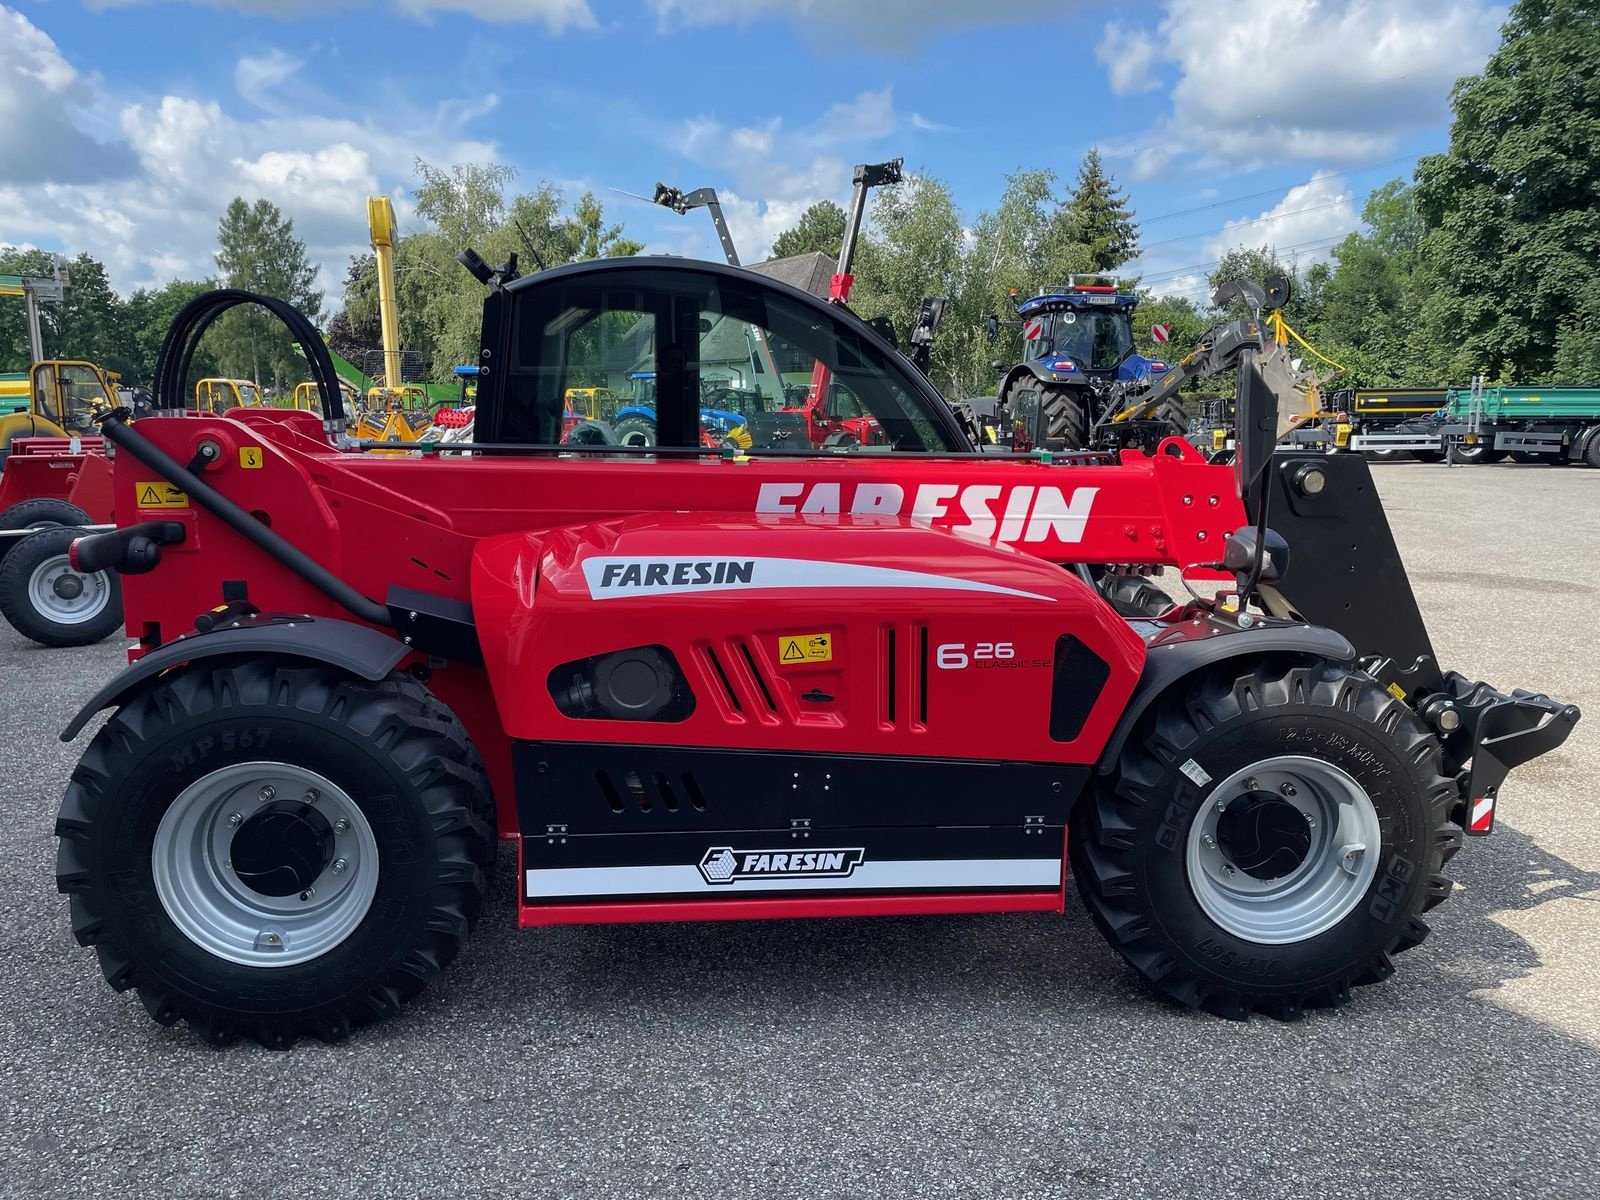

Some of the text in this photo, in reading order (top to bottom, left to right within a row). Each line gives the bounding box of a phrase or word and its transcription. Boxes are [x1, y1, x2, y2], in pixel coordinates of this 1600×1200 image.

[1065, 313, 1075, 322] 50
[600, 561, 755, 587] FARESIN
[937, 642, 1015, 669] 6 26
[975, 660, 1027, 669] CLASSIC
[222, 728, 273, 751] 567
[1156, 783, 1198, 850] BKT
[741, 853, 845, 872] FARESIN
[1369, 854, 1415, 923] BKT
